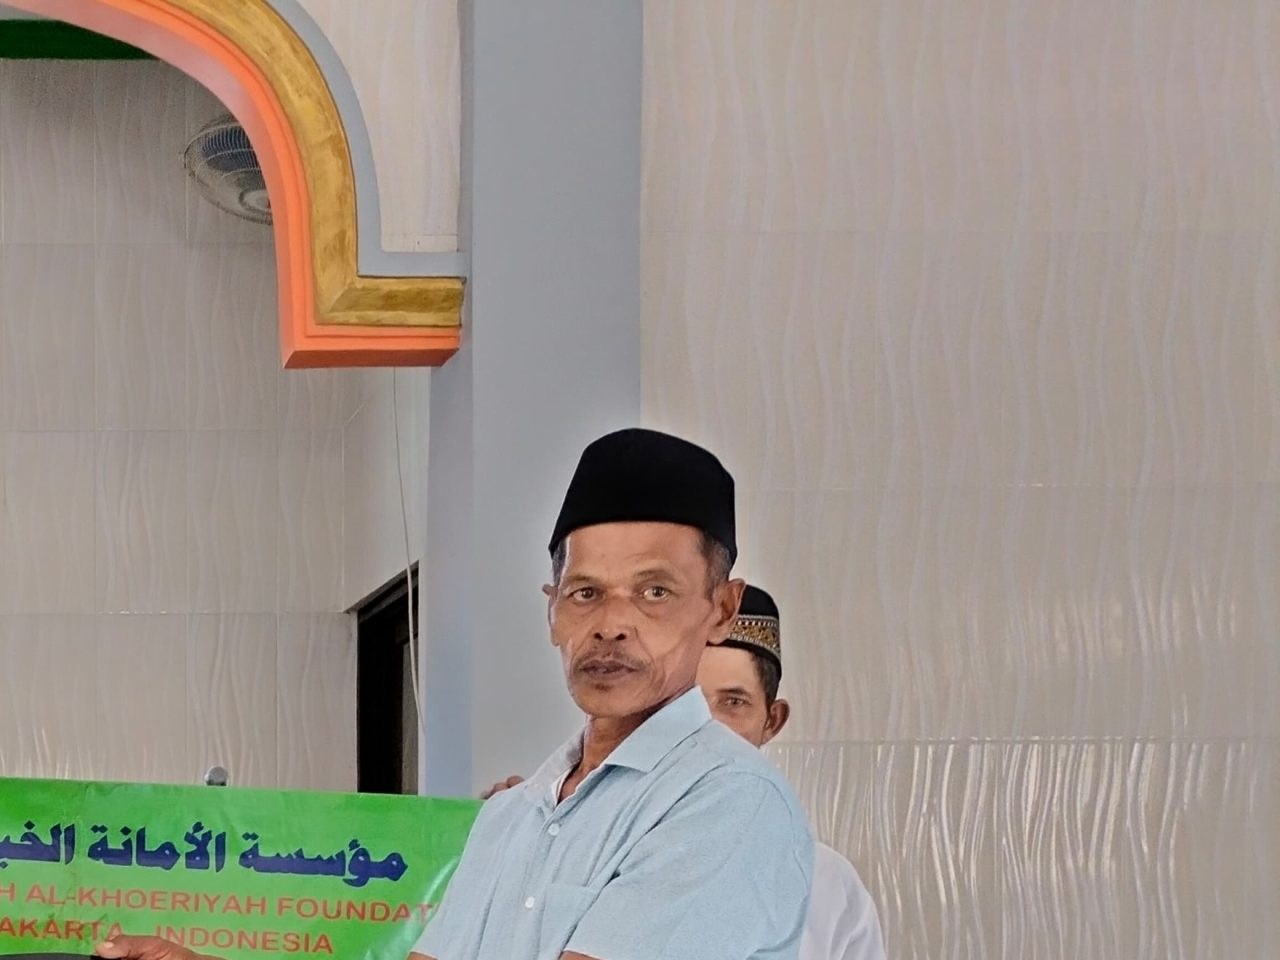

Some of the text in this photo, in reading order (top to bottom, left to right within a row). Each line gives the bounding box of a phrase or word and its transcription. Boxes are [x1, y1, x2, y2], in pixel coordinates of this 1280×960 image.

[88, 821, 227, 873] الأمانة
[238, 831, 409, 887] مؤسسة
[26, 884, 266, 915] AL-KHOERIYAH
[277, 897, 438, 924] FOUNDAT
[155, 925, 333, 954] INDONESIA
